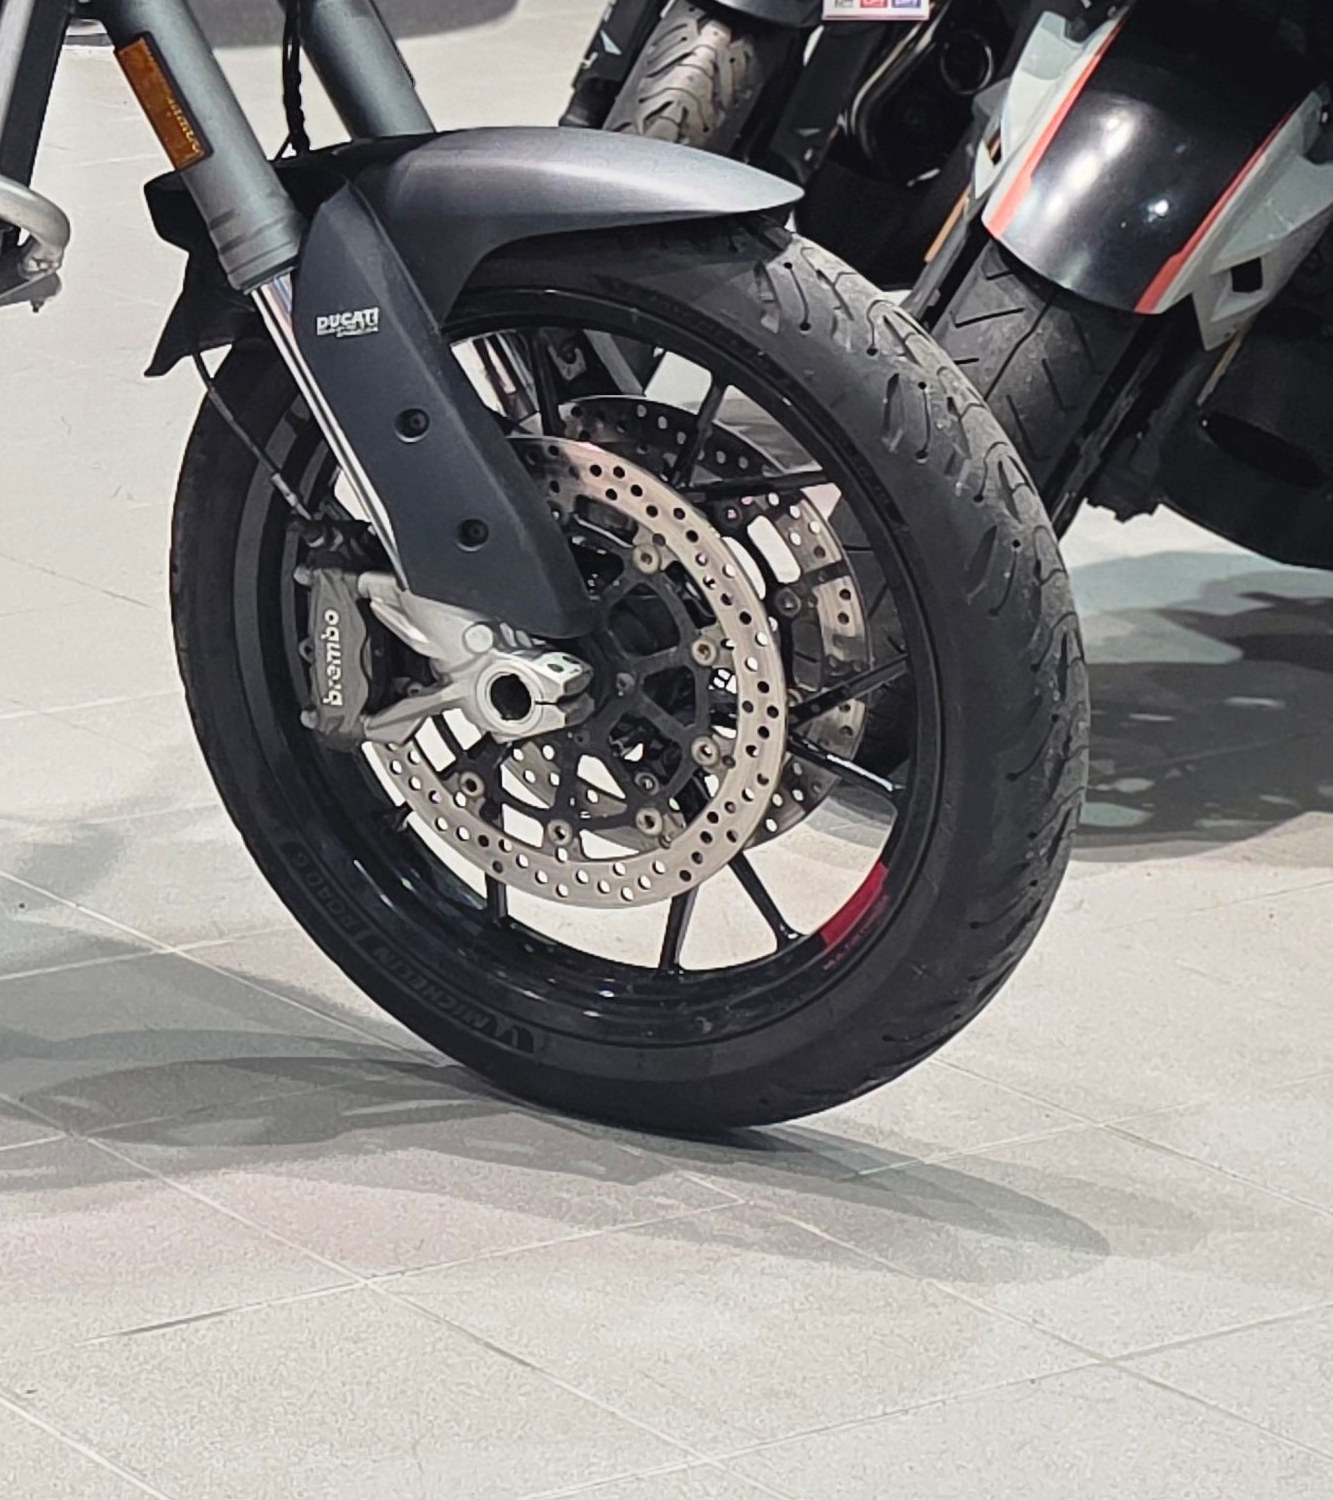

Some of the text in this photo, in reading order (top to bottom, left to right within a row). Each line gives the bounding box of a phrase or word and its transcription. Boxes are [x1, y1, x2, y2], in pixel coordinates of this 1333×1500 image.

[316, 307, 379, 330] DUCATI
[321, 609, 344, 706] brembo
[372, 946, 493, 1031] MICHELIN
